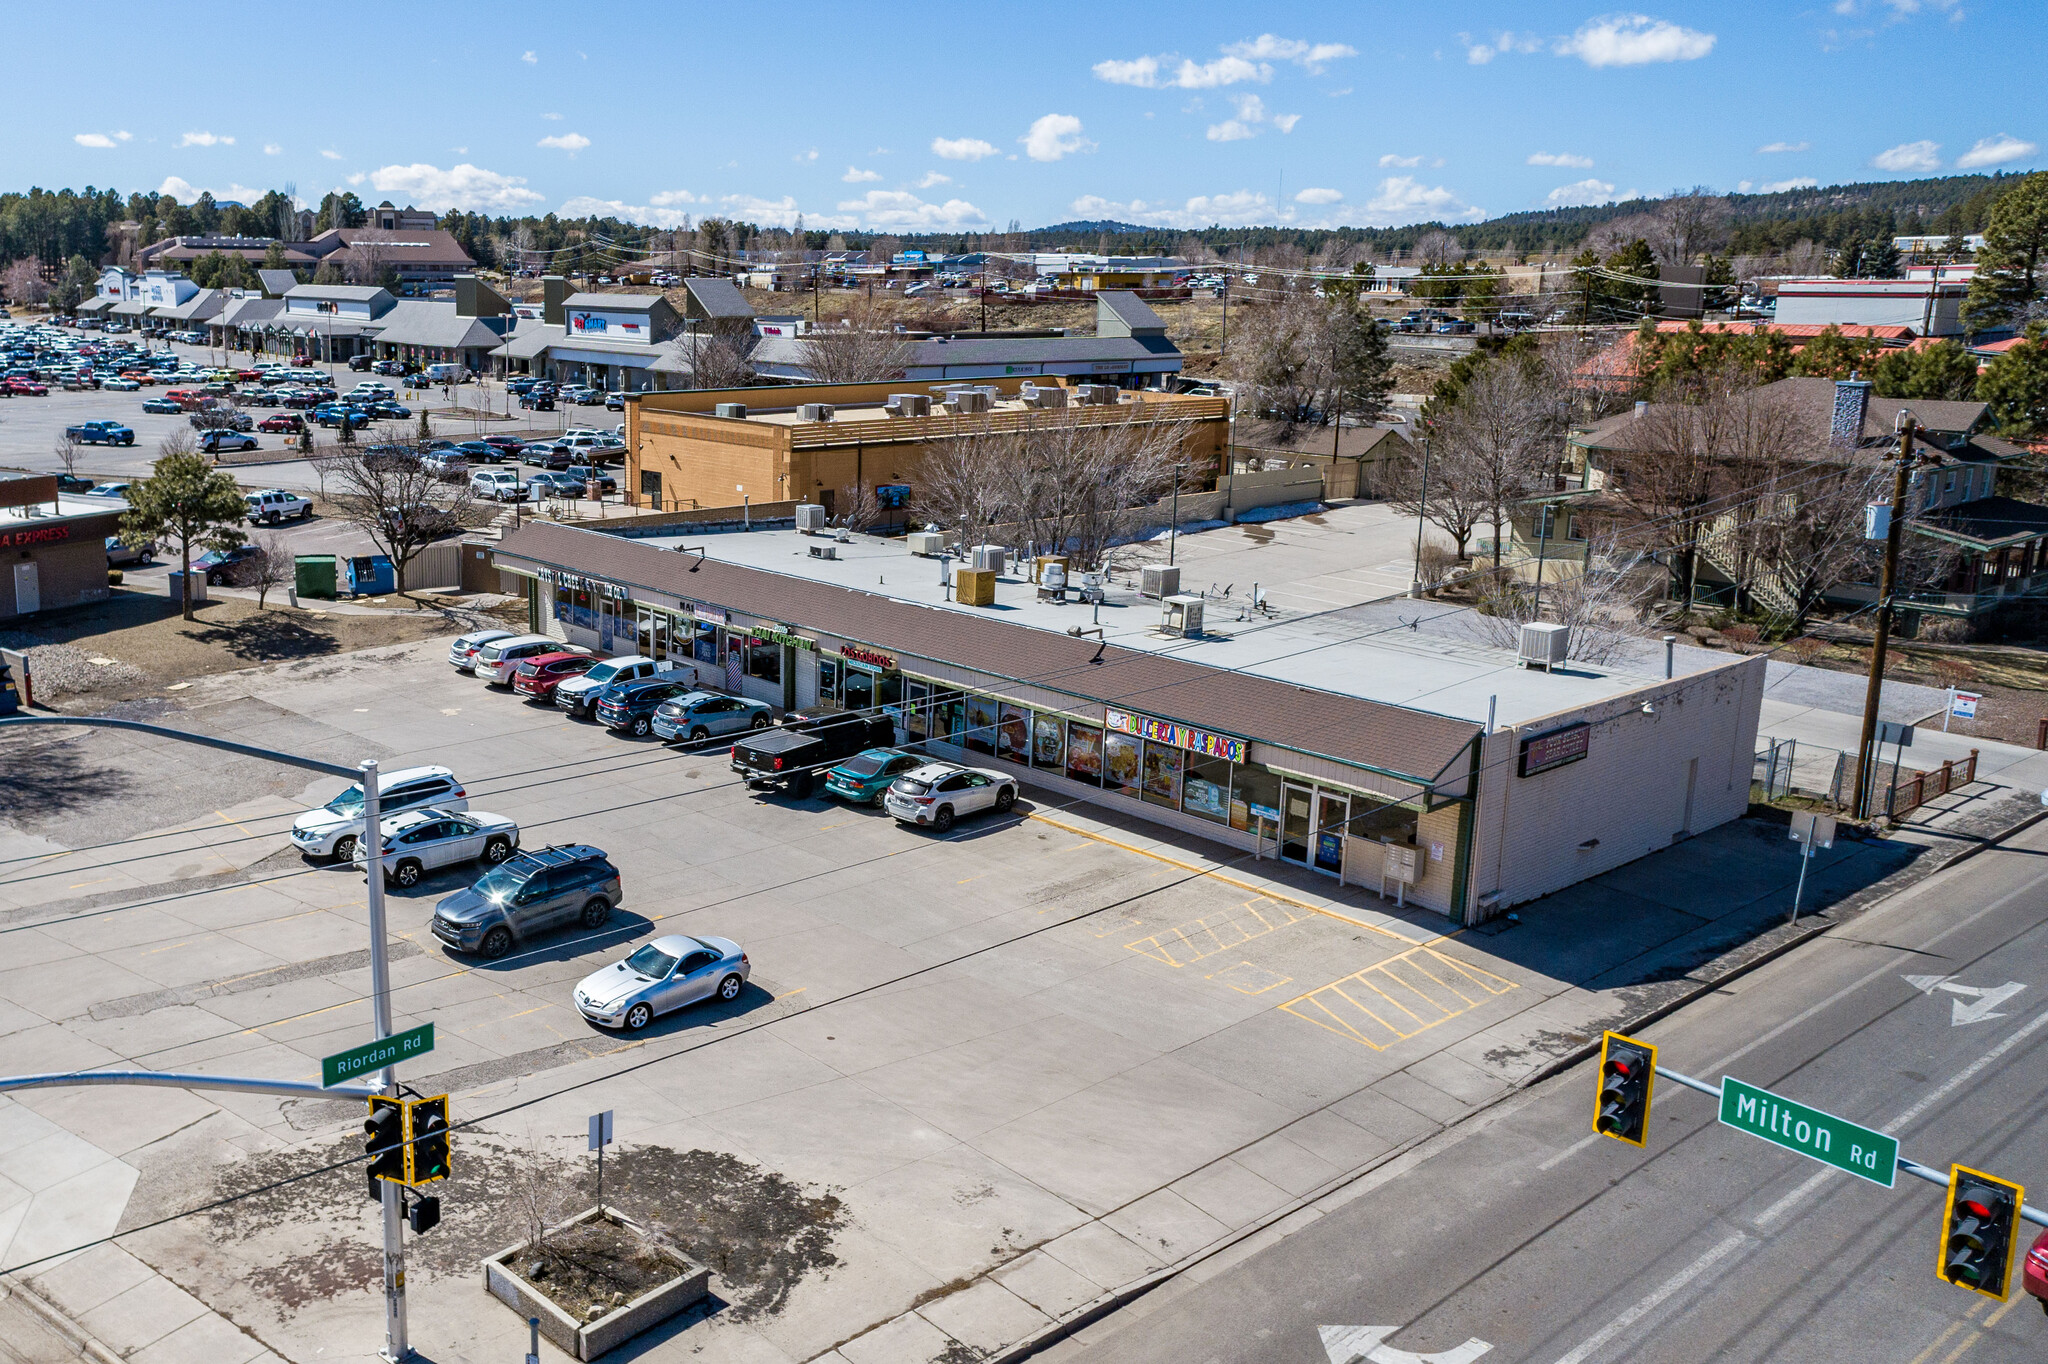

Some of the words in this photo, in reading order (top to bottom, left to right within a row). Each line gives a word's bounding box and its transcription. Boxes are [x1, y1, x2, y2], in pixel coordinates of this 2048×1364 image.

[15, 526, 70, 545] EXPRESS
[751, 626, 771, 641] THAI
[772, 631, 813, 651] KITCHEN
[841, 646, 855, 659] LOS
[856, 650, 890, 668] GORDOS
[1130, 715, 1176, 745] DULCERIA
[1178, 727, 1186, 747] Y
[1187, 730, 1242, 763] RASPADOS
[337, 1046, 396, 1074] Riordan
[403, 1034, 421, 1051] Rd
[1736, 1093, 1832, 1153] Milton
[1850, 1144, 1877, 1170] Rd
